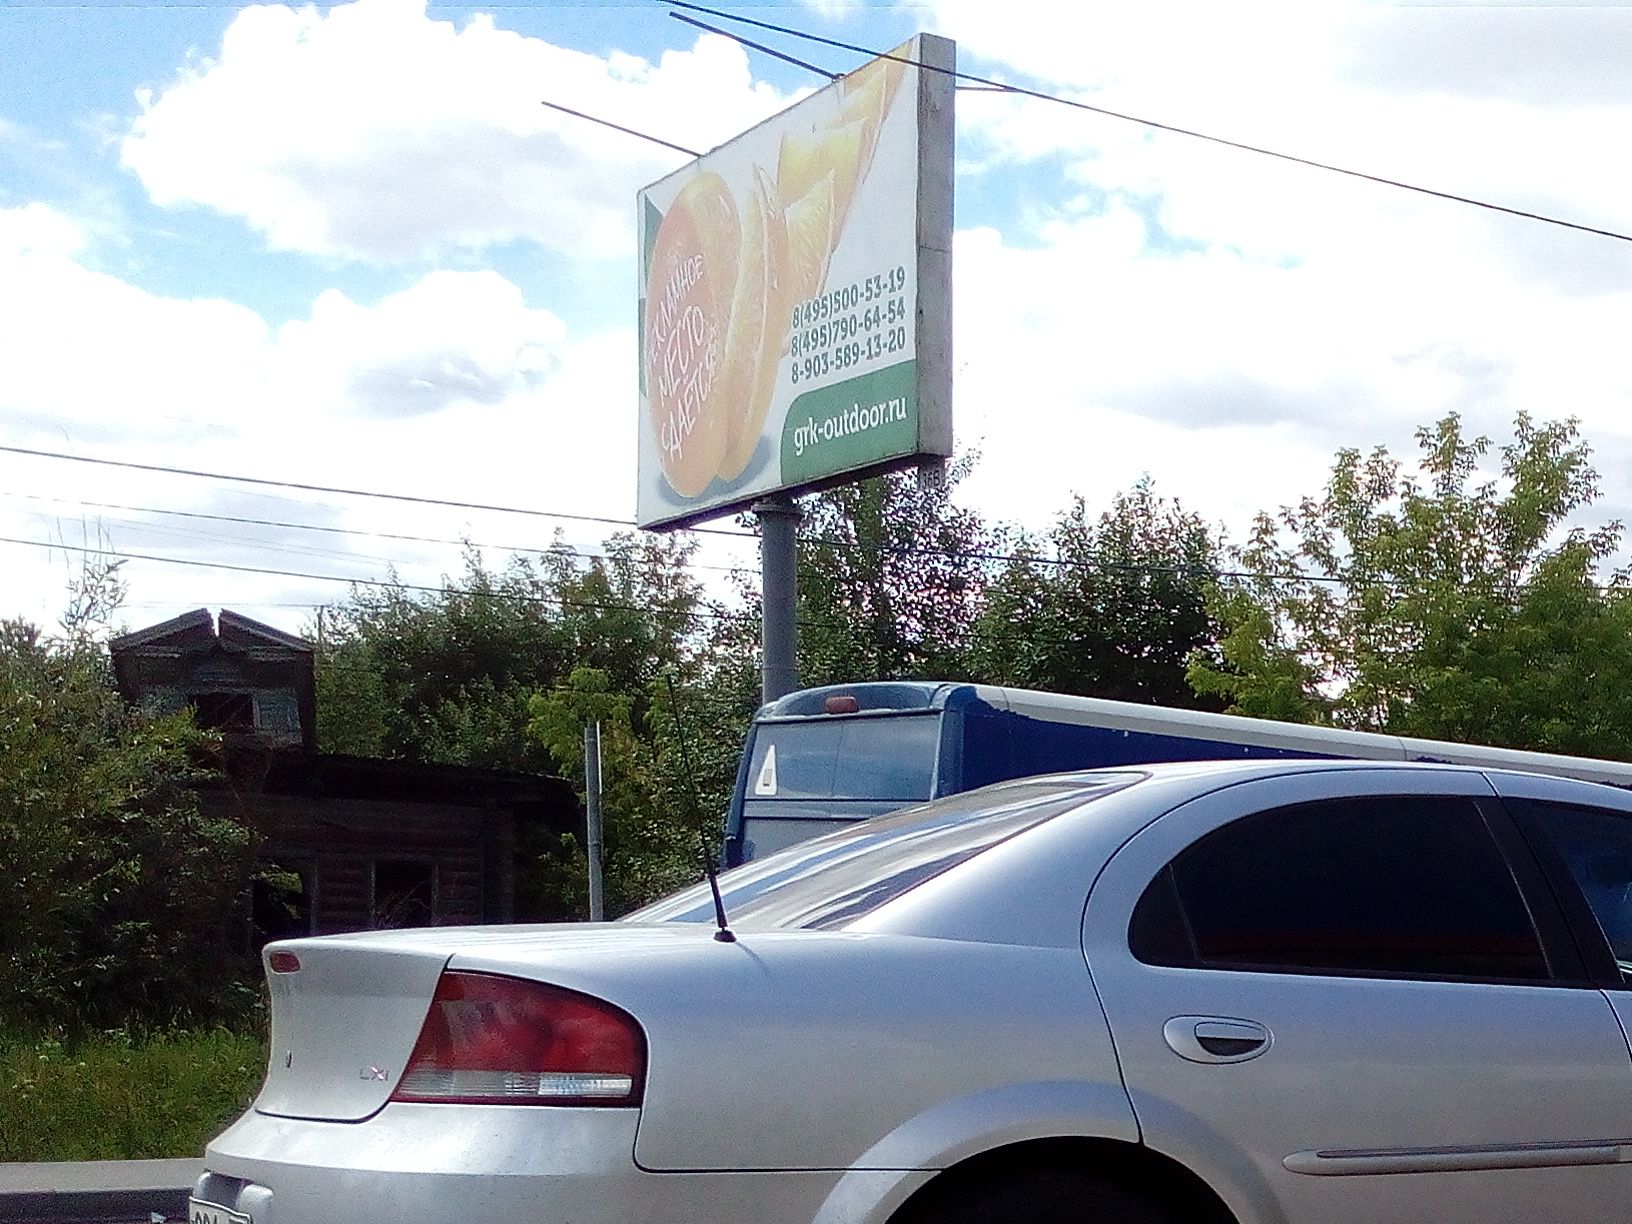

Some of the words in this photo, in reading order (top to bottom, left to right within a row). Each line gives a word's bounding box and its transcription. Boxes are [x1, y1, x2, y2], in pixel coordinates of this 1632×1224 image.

[648, 254, 704, 376] ЕКЛАМНОЕ
[791, 296, 906, 358] 8(495)790-64-54
[792, 265, 906, 329] 8(495)500-53-19
[791, 326, 906, 385] 8-903-589-13-20
[794, 397, 907, 456] grk-outdoor.ru
